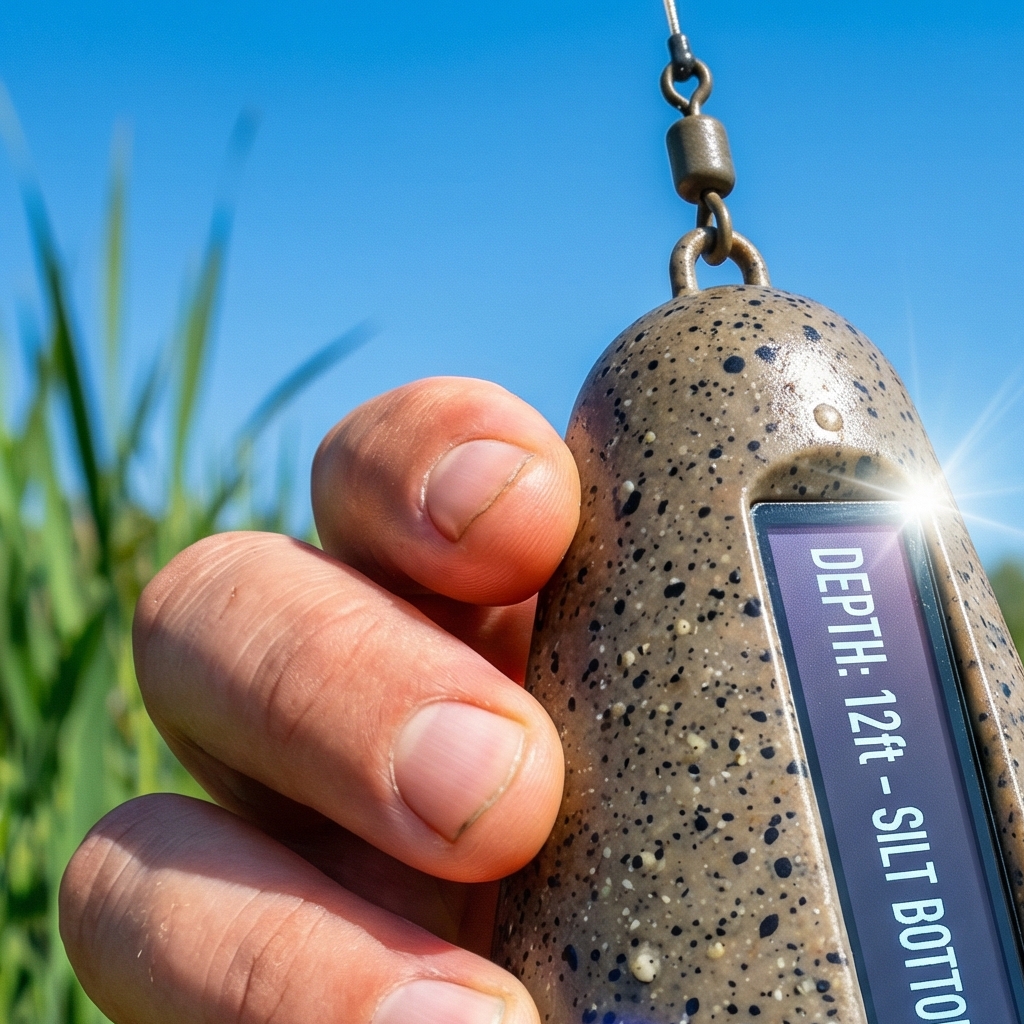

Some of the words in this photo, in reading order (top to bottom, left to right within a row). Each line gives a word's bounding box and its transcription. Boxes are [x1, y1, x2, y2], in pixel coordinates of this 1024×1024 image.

[810, 547, 888, 677] DEPTH:
[844, 689, 907, 765] 12ft
[879, 776, 892, 795] -
[871, 806, 938, 884] SILT
